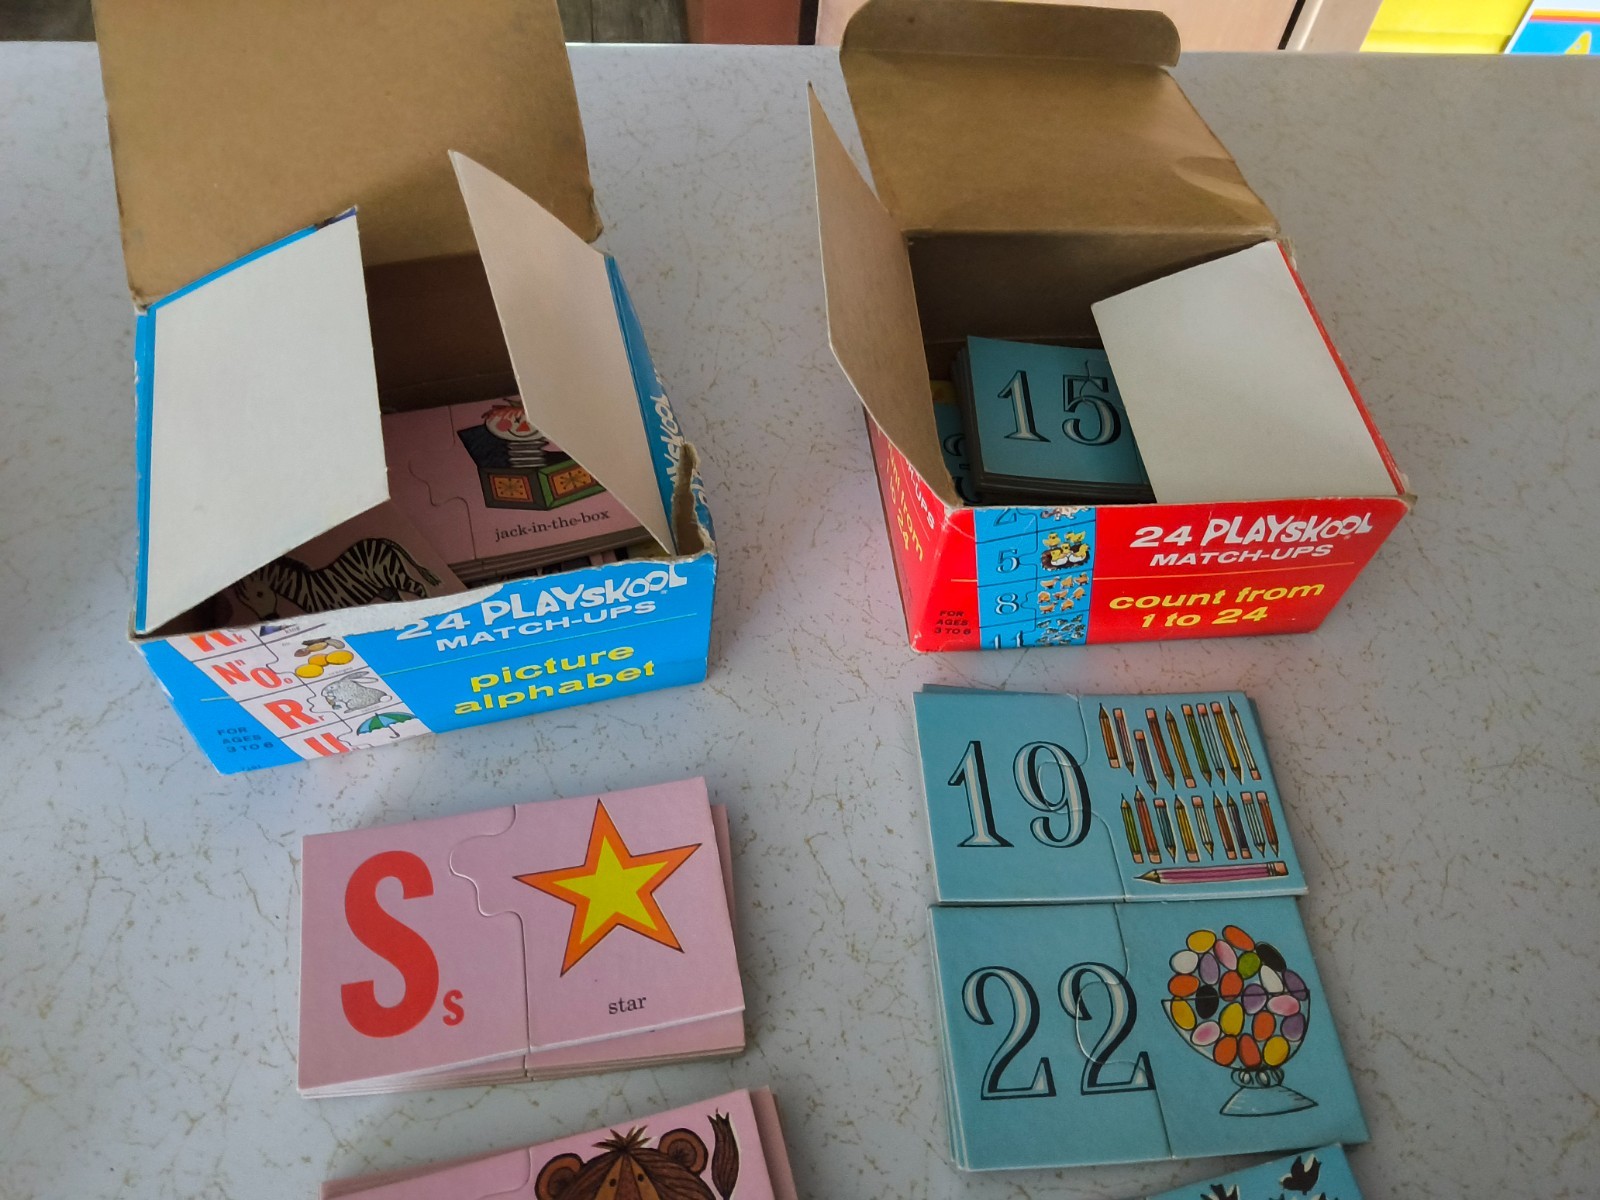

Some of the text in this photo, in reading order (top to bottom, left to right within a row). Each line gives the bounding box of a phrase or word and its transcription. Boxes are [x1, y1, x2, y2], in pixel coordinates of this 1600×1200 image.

[997, 370, 1122, 446] 15
[494, 509, 610, 543] jack-in-the-box
[1129, 512, 1374, 548] 24 PLAYSKOOL
[996, 548, 1020, 574] 5
[1149, 544, 1334, 567] MATCH-UPS
[396, 564, 688, 641] 24 PLAYSKOOL
[994, 591, 1019, 616] 8
[1108, 583, 1326, 610] count from
[436, 600, 657, 652] MATCH-UPS
[1141, 606, 1269, 629] 1 to 24
[469, 645, 636, 694] picture
[453, 660, 656, 715] alphabet
[216, 726, 249, 736] FOR
[222, 734, 262, 745] AGES
[240, 743, 260, 751] TO
[947, 740, 1093, 848] 19
[607, 995, 648, 1017] star
[961, 961, 1157, 1101] 22
